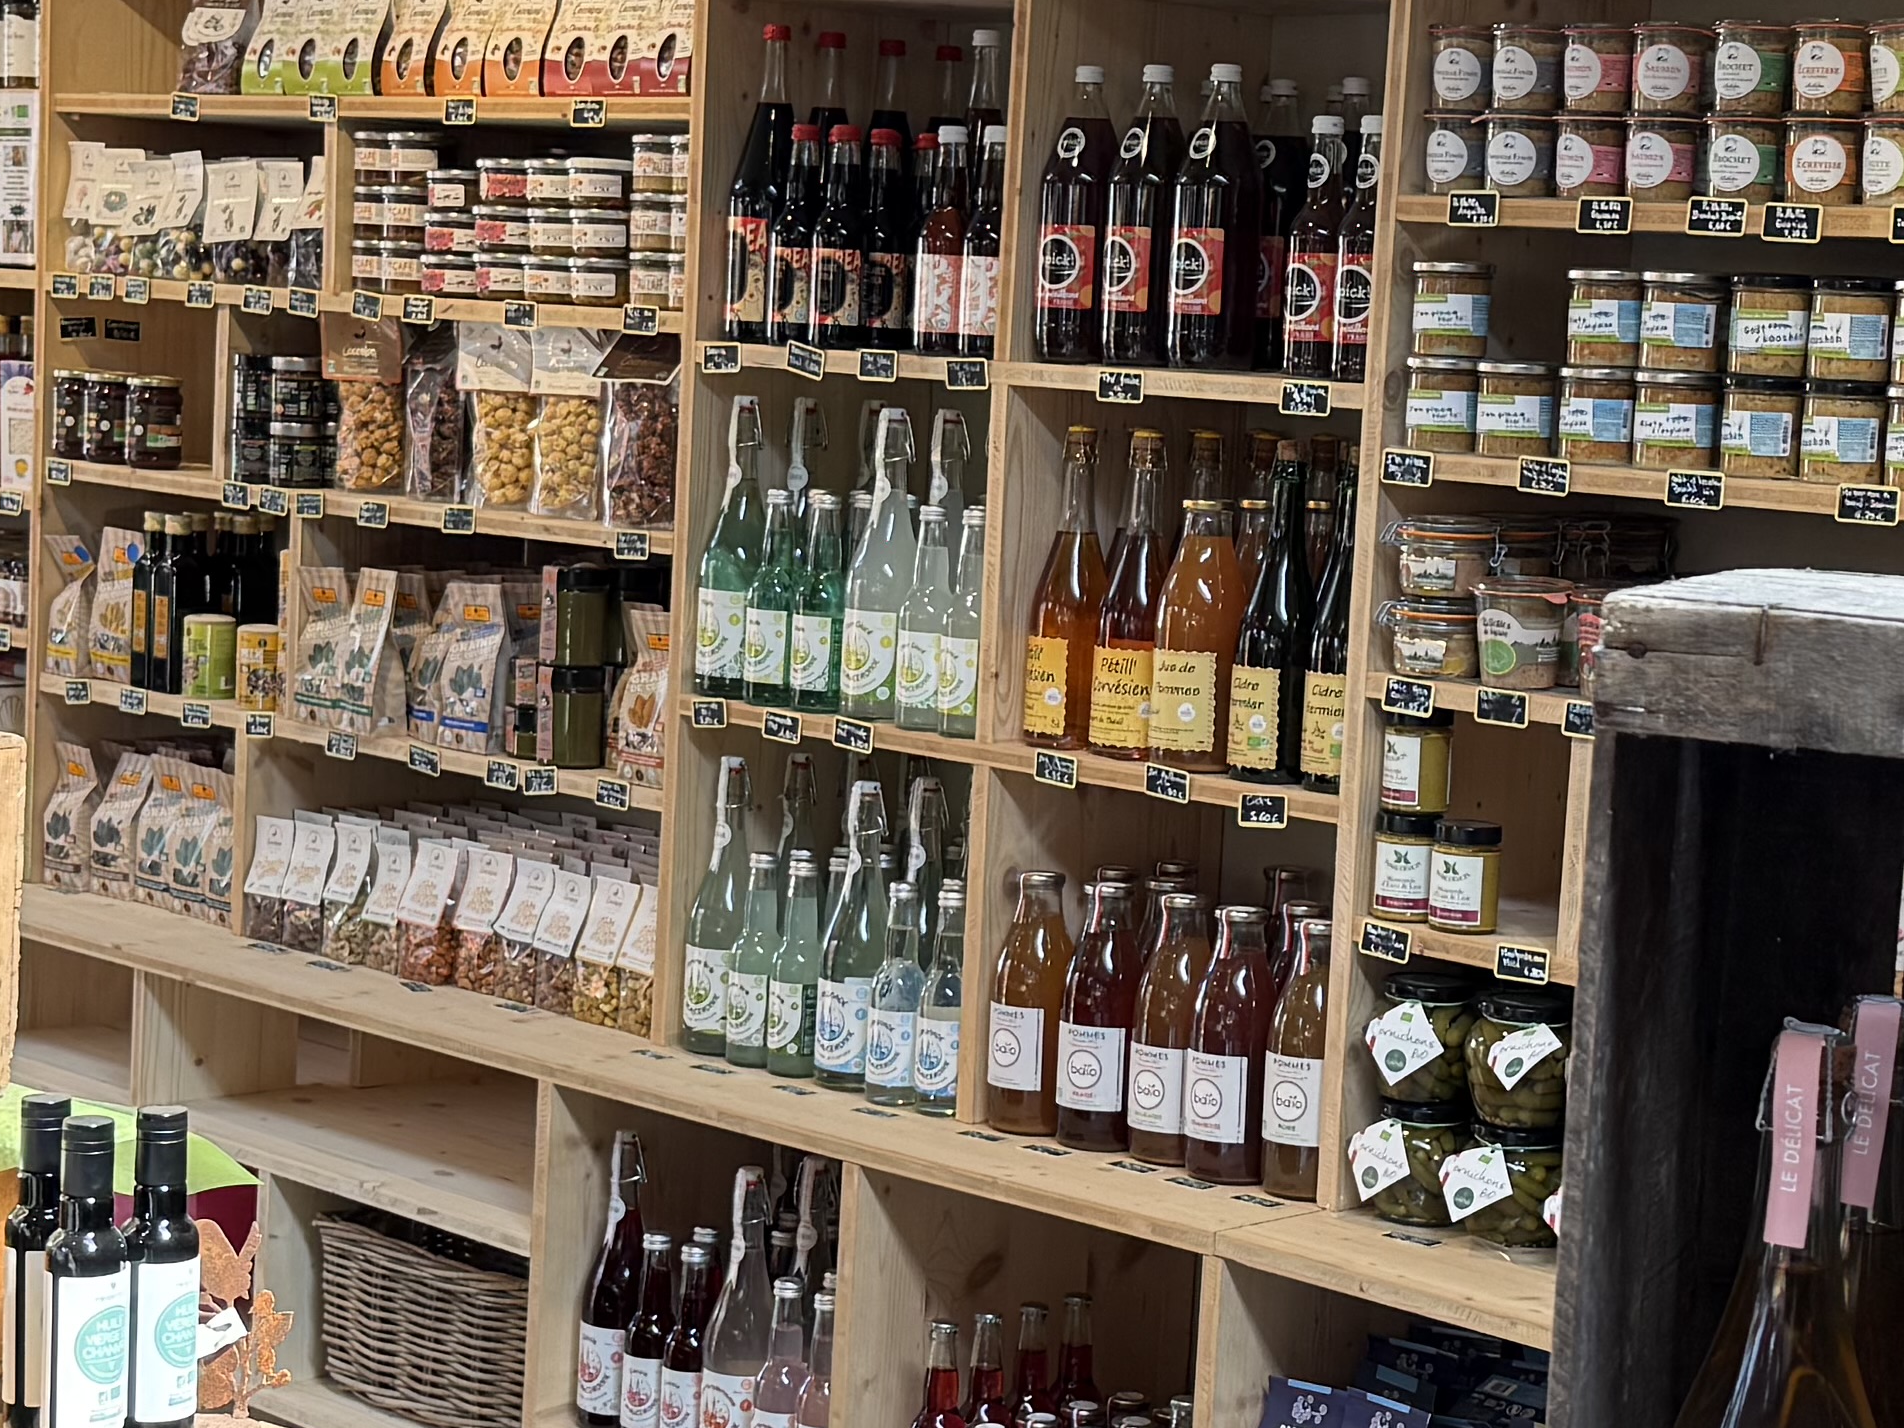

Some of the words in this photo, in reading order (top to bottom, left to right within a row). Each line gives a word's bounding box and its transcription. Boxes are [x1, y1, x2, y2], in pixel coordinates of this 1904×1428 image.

[1856, 1050, 1881, 1129] DÉLICAT
[1781, 1084, 1803, 1164] DÉLICAT
[1852, 1136, 1870, 1155] LE
[1780, 1173, 1798, 1192] LE
